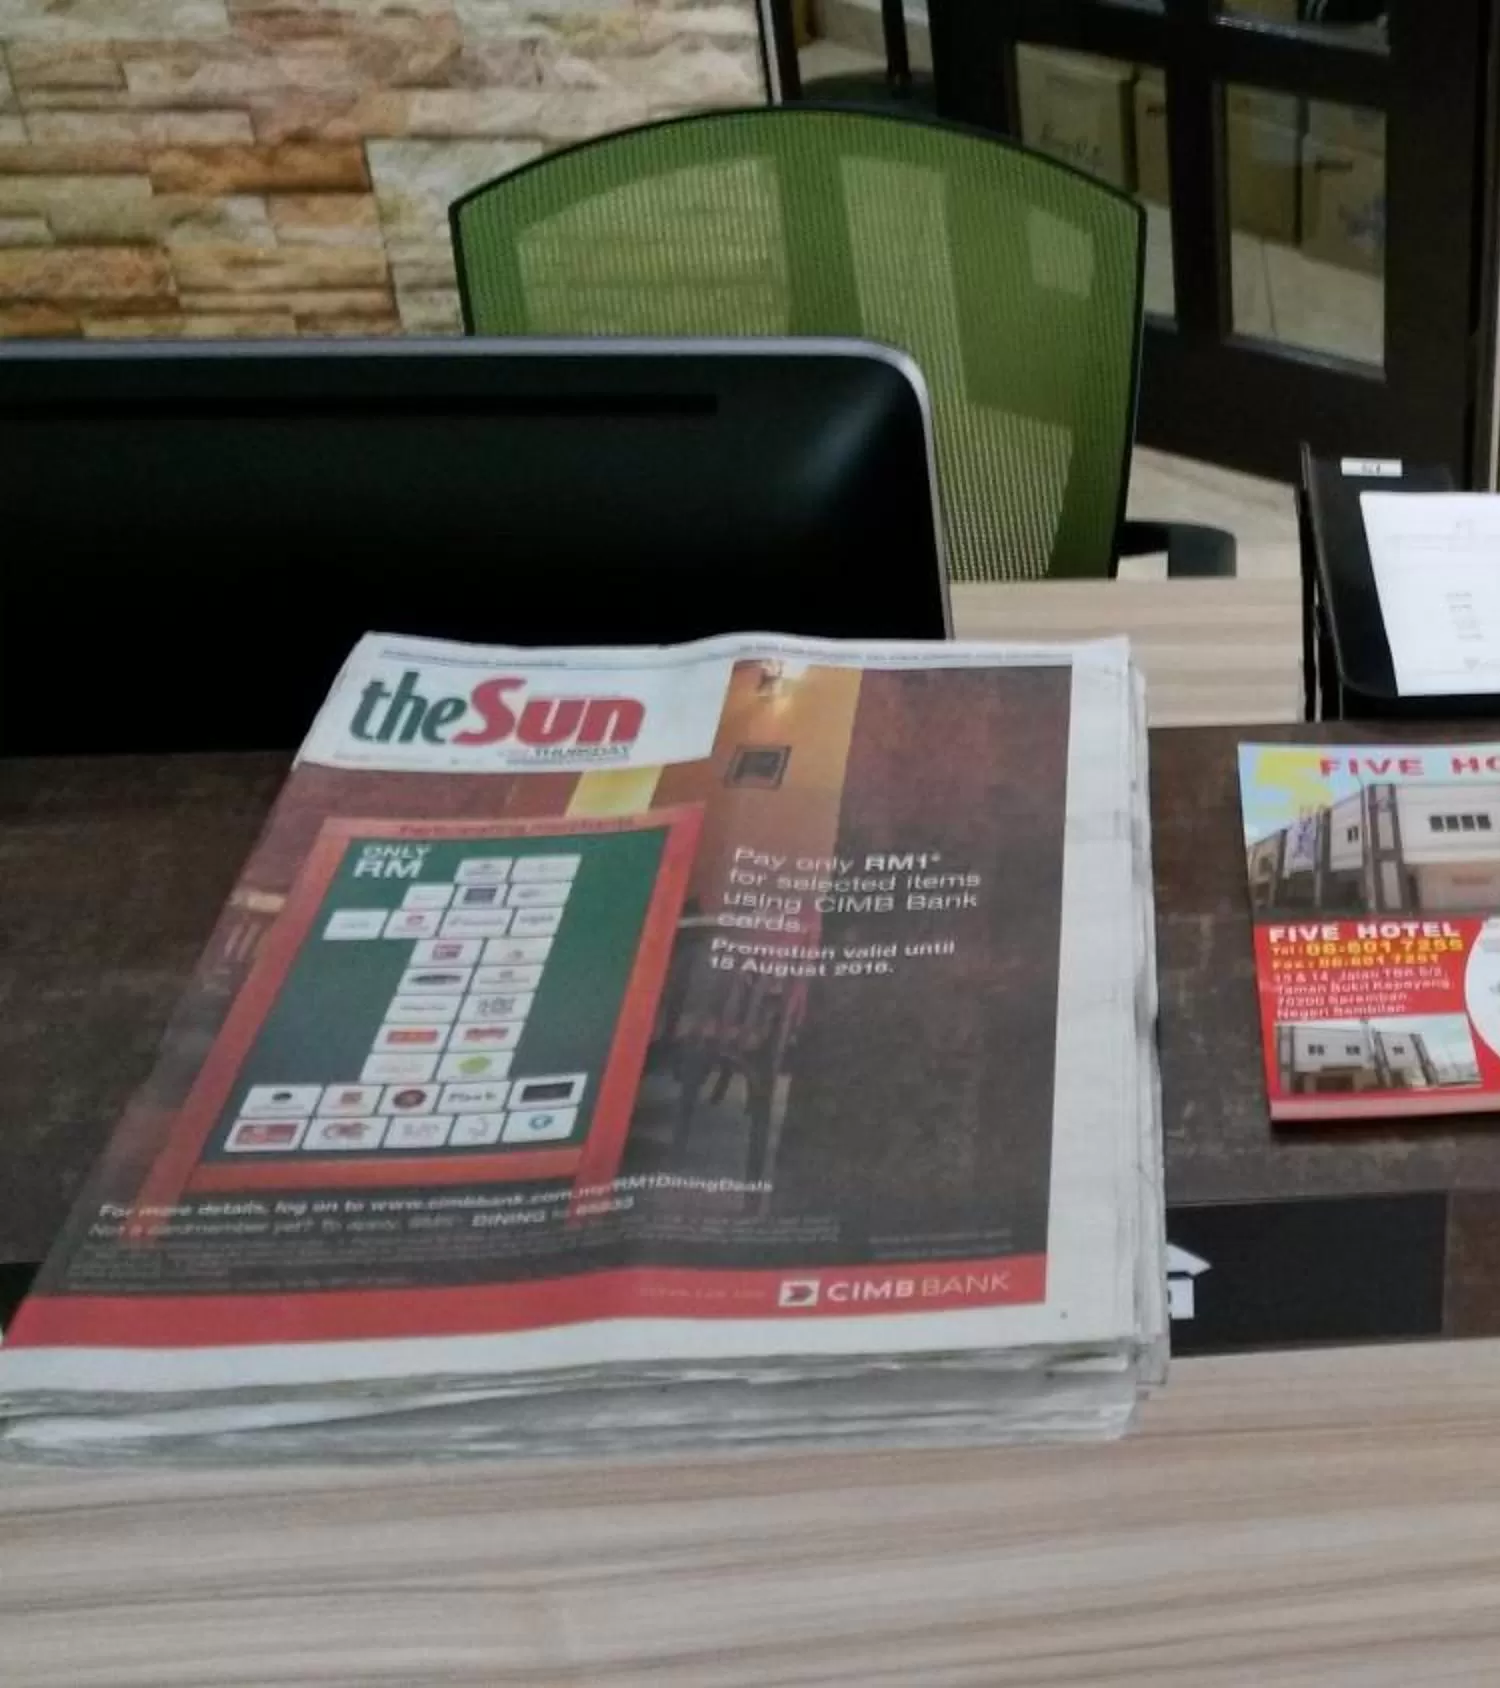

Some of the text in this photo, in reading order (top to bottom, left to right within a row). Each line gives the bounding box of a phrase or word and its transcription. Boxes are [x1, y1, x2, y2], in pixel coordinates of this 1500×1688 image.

[350, 670, 646, 746] theSun
[1319, 757, 1425, 777] FIVE
[362, 844, 432, 858] ONLY
[735, 846, 786, 870] Pay
[796, 856, 853, 874] only
[353, 859, 424, 878] RM
[730, 868, 981, 893] for selected items
[723, 891, 977, 914] using CIMB Bank
[1269, 921, 1461, 943] FIVE HOTEL
[711, 937, 955, 960] Promotion valid until
[741, 959, 828, 978] August
[100, 1203, 134, 1217] For
[275, 1200, 308, 1217] log
[311, 1201, 339, 1213] on
[827, 1271, 1012, 1303] CIMB BANK
